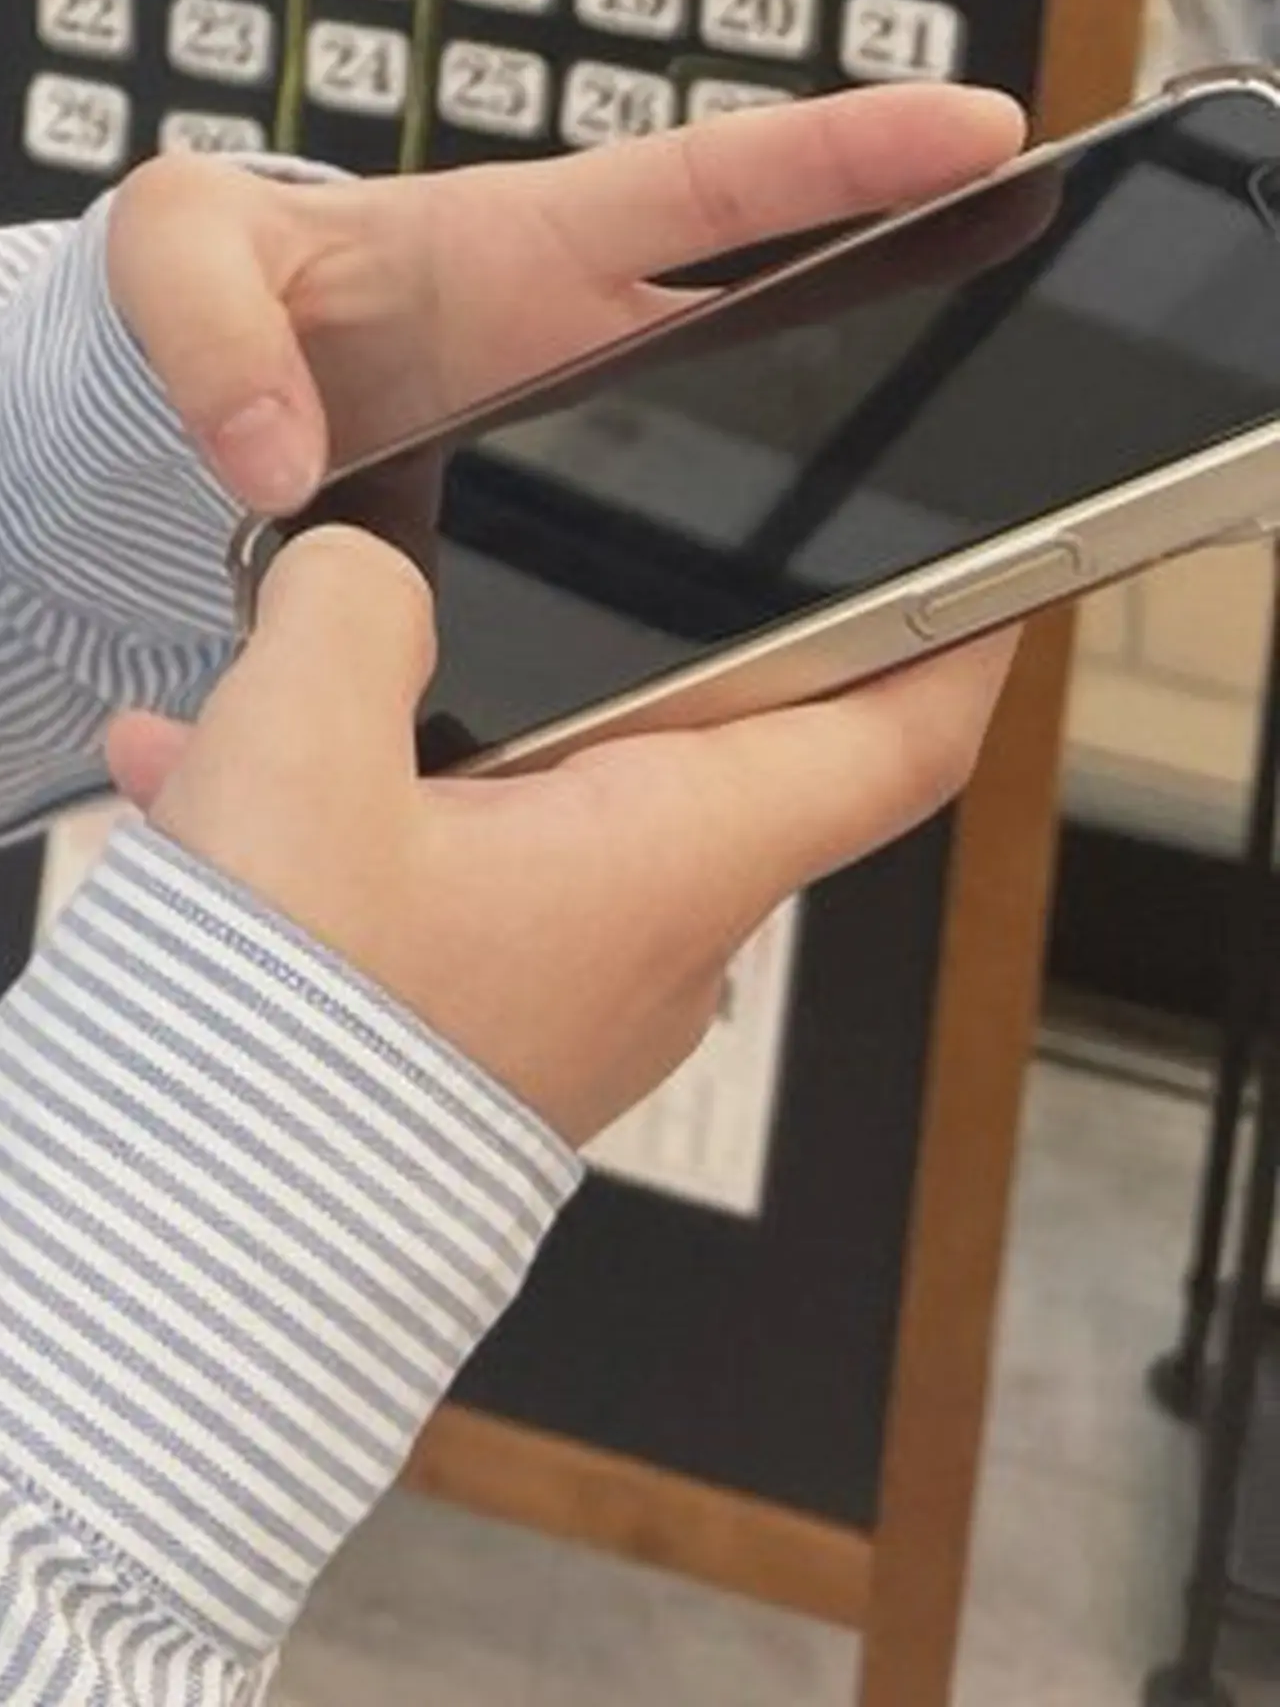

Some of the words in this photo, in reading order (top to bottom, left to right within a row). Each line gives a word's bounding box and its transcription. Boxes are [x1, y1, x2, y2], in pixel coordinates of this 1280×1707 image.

[183, 0, 255, 65] 23
[321, 37, 393, 94] 24
[455, 54, 529, 116] 25
[859, 8, 930, 69] 21
[46, 86, 110, 150] 29
